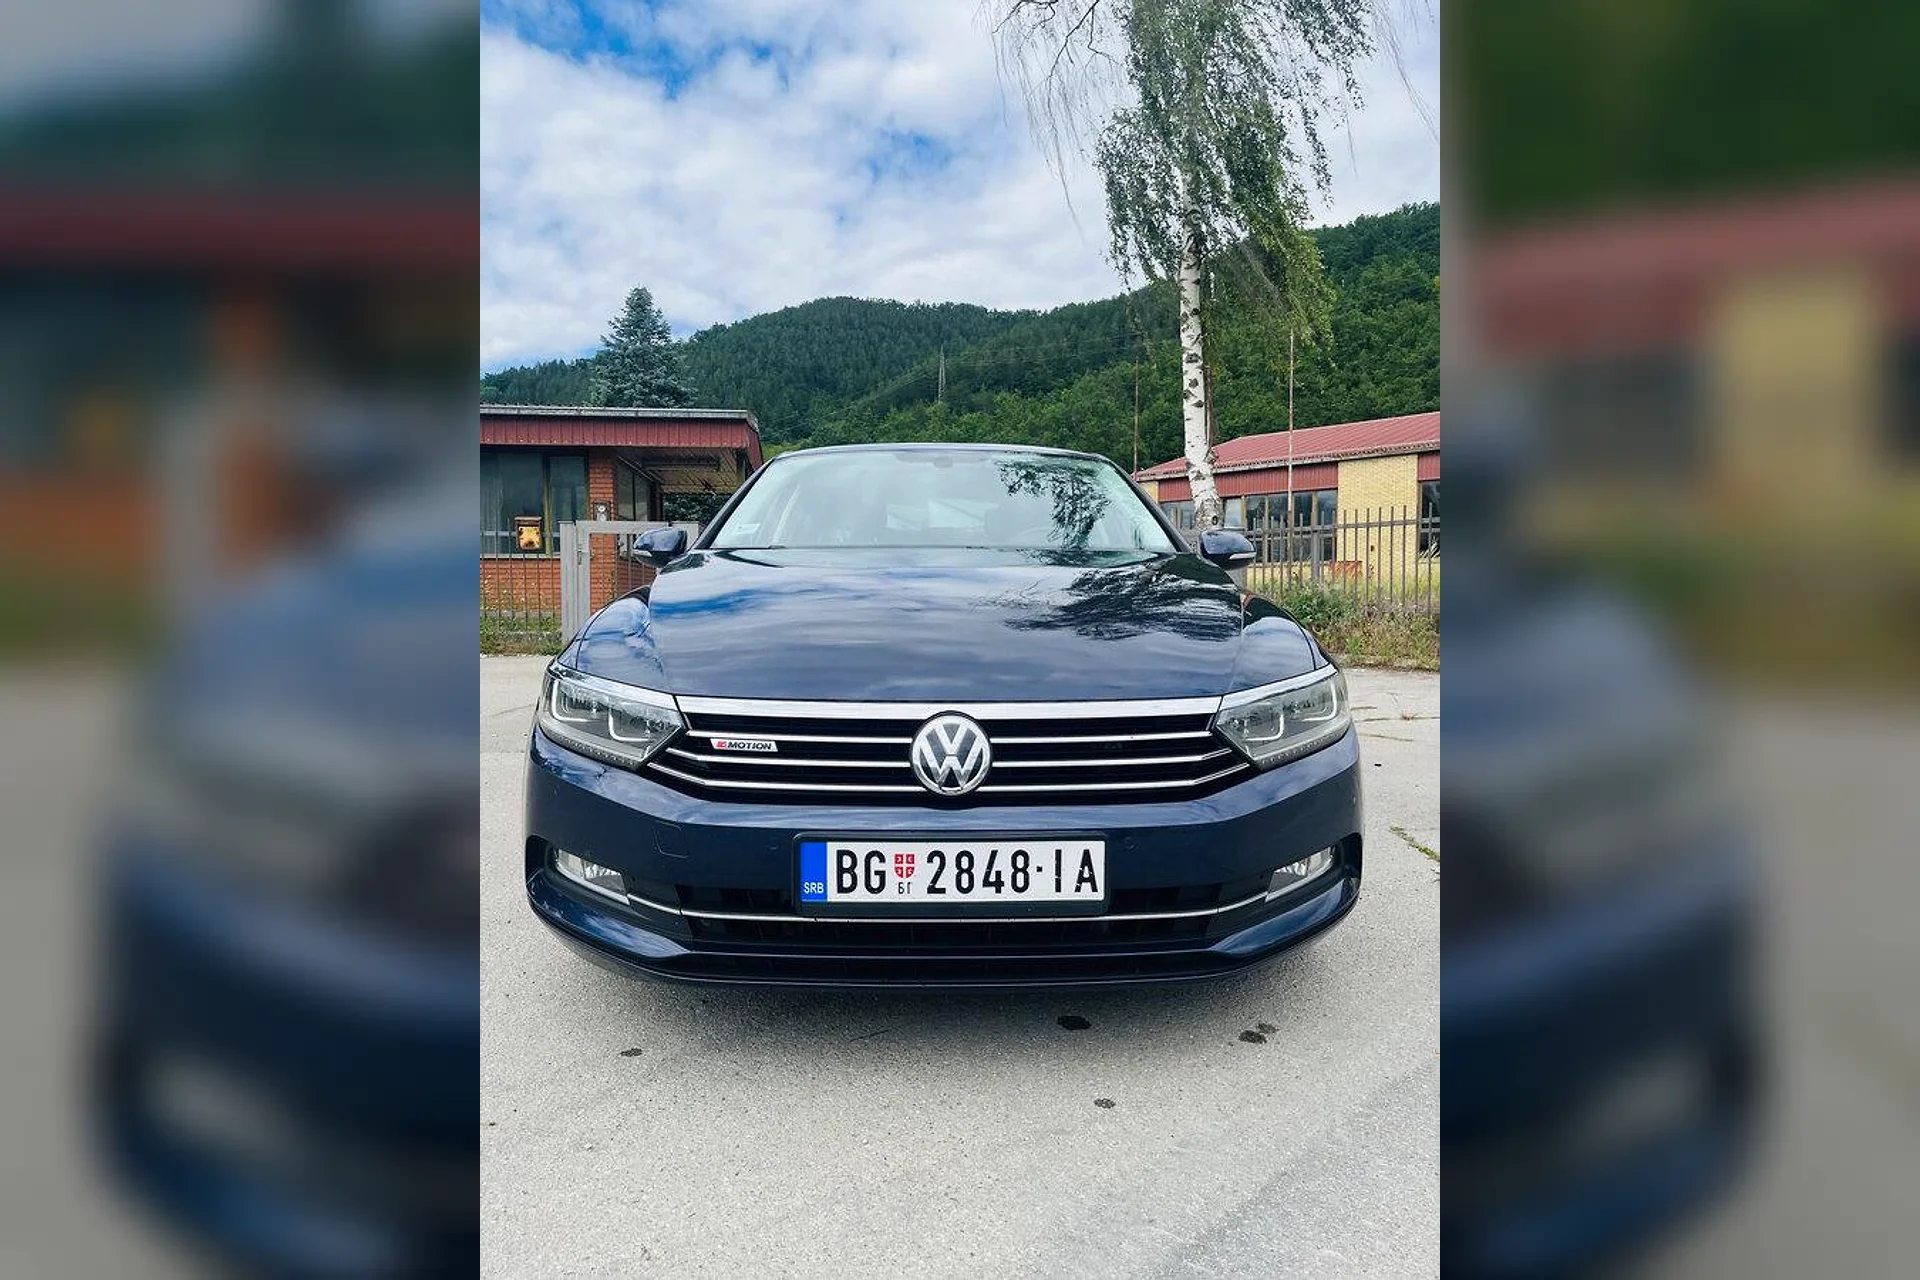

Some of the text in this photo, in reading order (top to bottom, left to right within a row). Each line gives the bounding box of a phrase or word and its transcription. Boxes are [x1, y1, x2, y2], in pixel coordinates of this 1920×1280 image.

[916, 718, 986, 791] VW
[803, 881, 824, 894] SRB
[836, 849, 886, 895] BG
